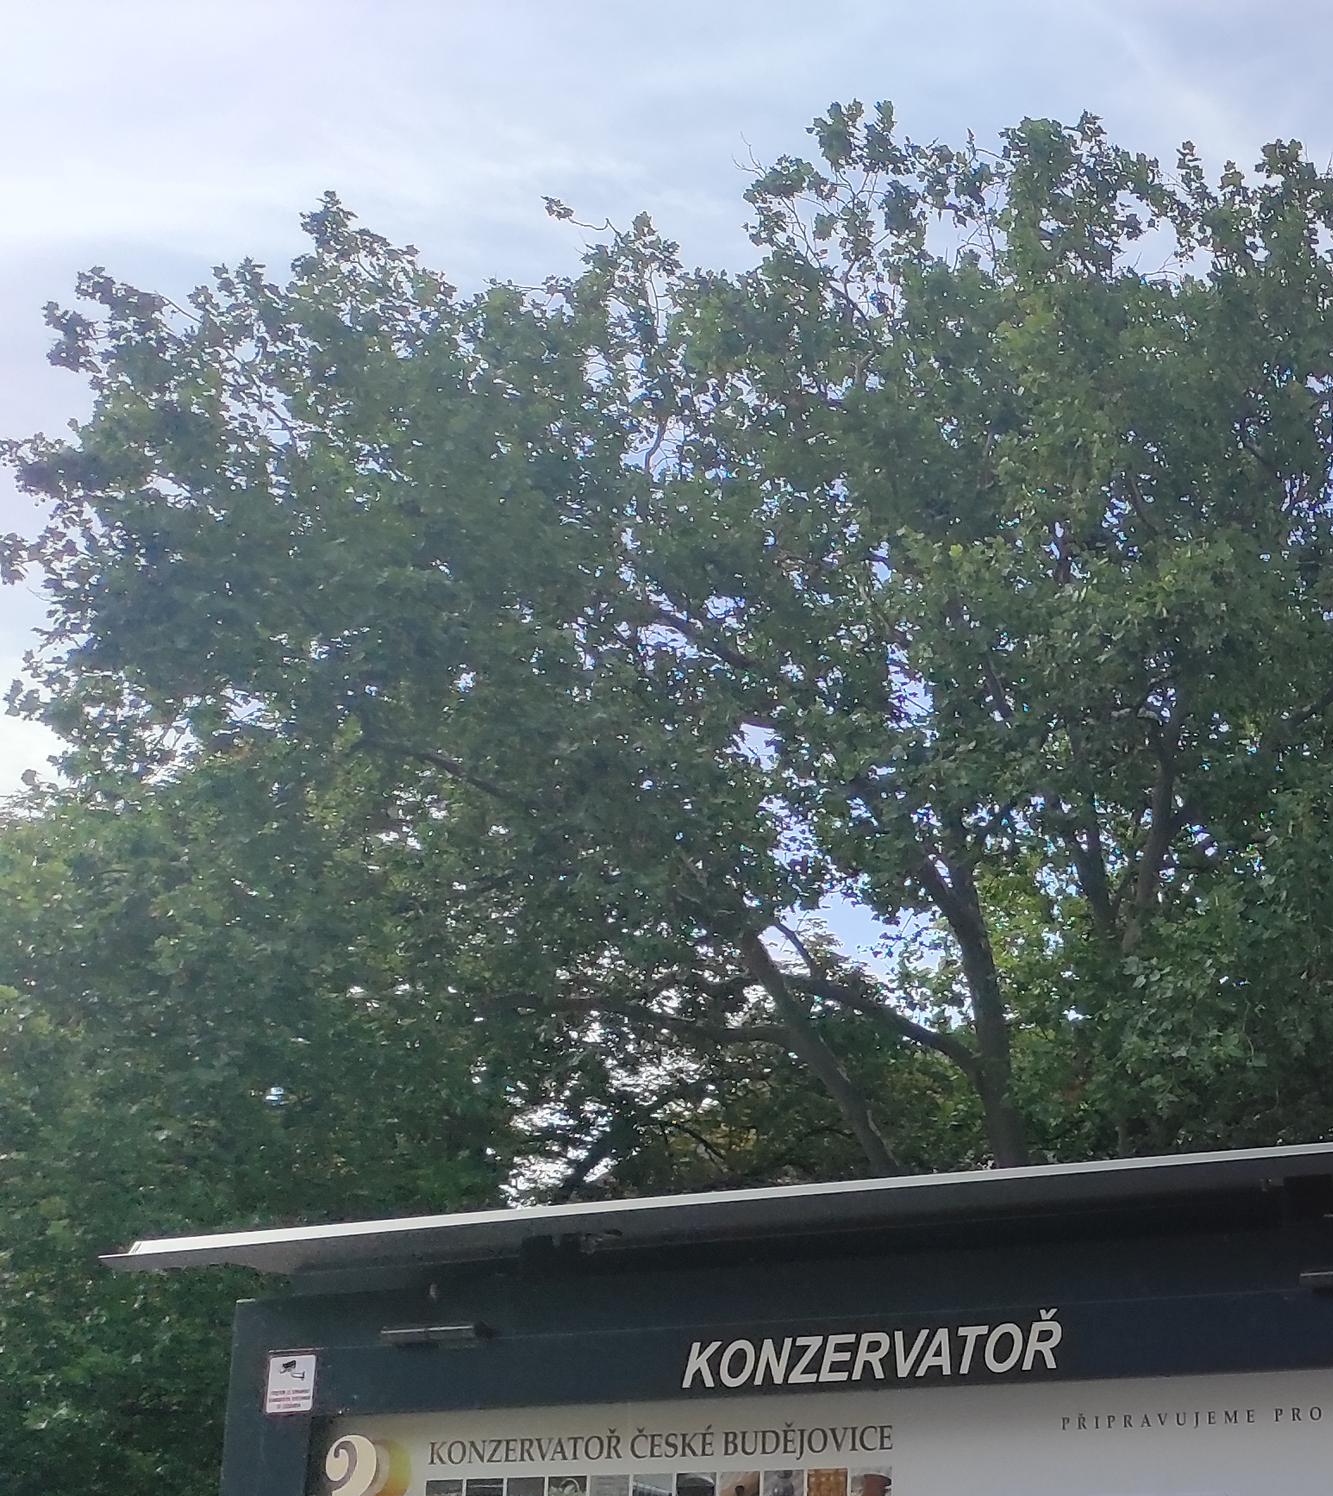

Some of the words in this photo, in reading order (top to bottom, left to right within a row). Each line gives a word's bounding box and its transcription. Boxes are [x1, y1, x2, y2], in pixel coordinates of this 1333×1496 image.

[681, 1308, 1062, 1389] KONZERVATOŘ
[1061, 1408, 1256, 1431] PŘIPRAVUJEME
[1273, 1406, 1324, 1422] PRO
[428, 1428, 622, 1466] KONZERVATOŘ
[629, 1426, 715, 1460] ČESKÉ
[723, 1421, 894, 1461] BUDĚJOVICE
